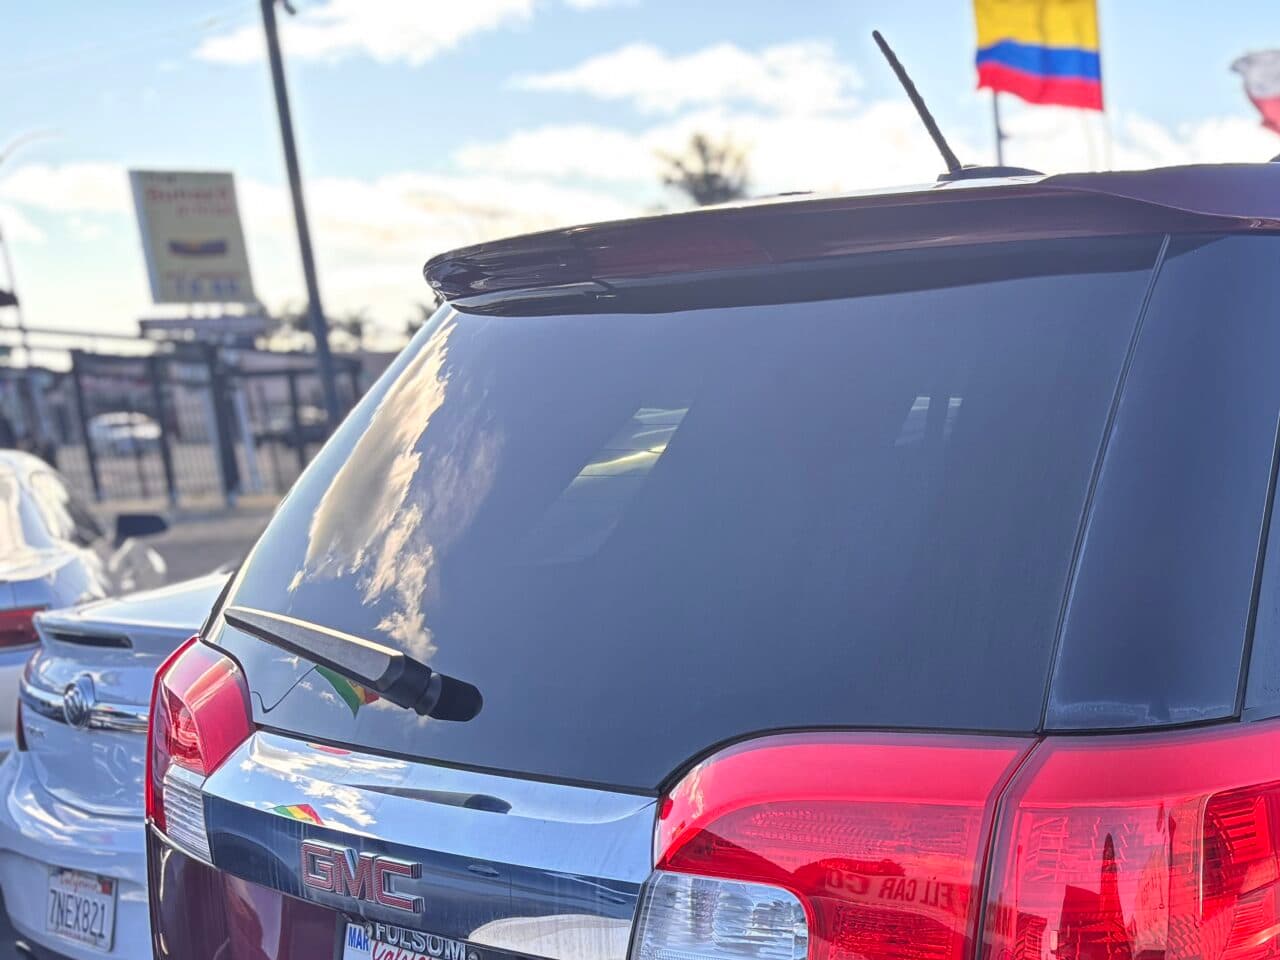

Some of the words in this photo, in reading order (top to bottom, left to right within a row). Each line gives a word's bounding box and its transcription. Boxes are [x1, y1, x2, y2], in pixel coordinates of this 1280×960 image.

[303, 839, 425, 913] GMC
[50, 888, 105, 939] 7NEX821
[347, 925, 369, 951] MAR
